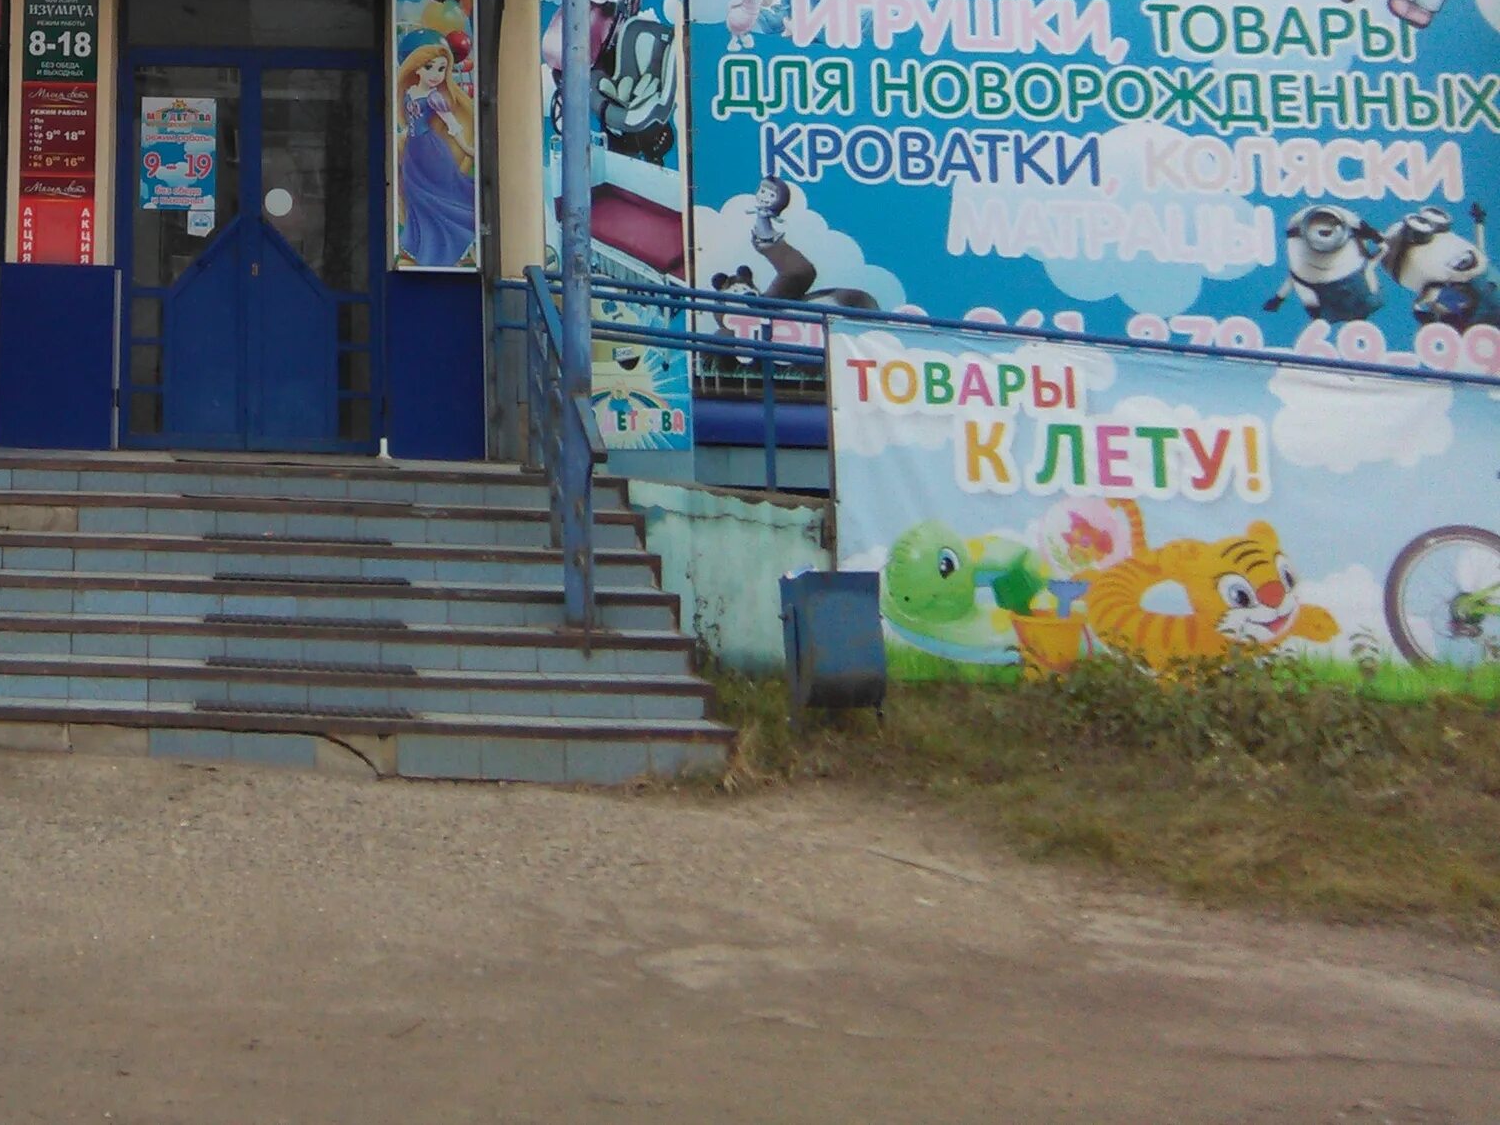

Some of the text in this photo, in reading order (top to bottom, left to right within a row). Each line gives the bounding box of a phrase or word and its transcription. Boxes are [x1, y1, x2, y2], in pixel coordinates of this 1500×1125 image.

[28, 4, 94, 17] ИЗУМРУД
[1145, 3, 1413, 59] ТОВАРЫ
[28, 30, 92, 58] 8-18
[716, 59, 1500, 131] ДЛЯ НОВОРОЖДЕННЫХ
[144, 152, 160, 177] 9
[184, 153, 212, 179] 19
[1142, 136, 1464, 202] КОЛЯСКИ
[22, 206, 33, 263] АКЦИЯ
[80, 207, 91, 264] АКЦИЯ
[948, 200, 1275, 273] МАТРАЦЫ
[846, 356, 1077, 410] ТОВАРЫ
[963, 421, 1264, 492] К ЛЕТУ!
